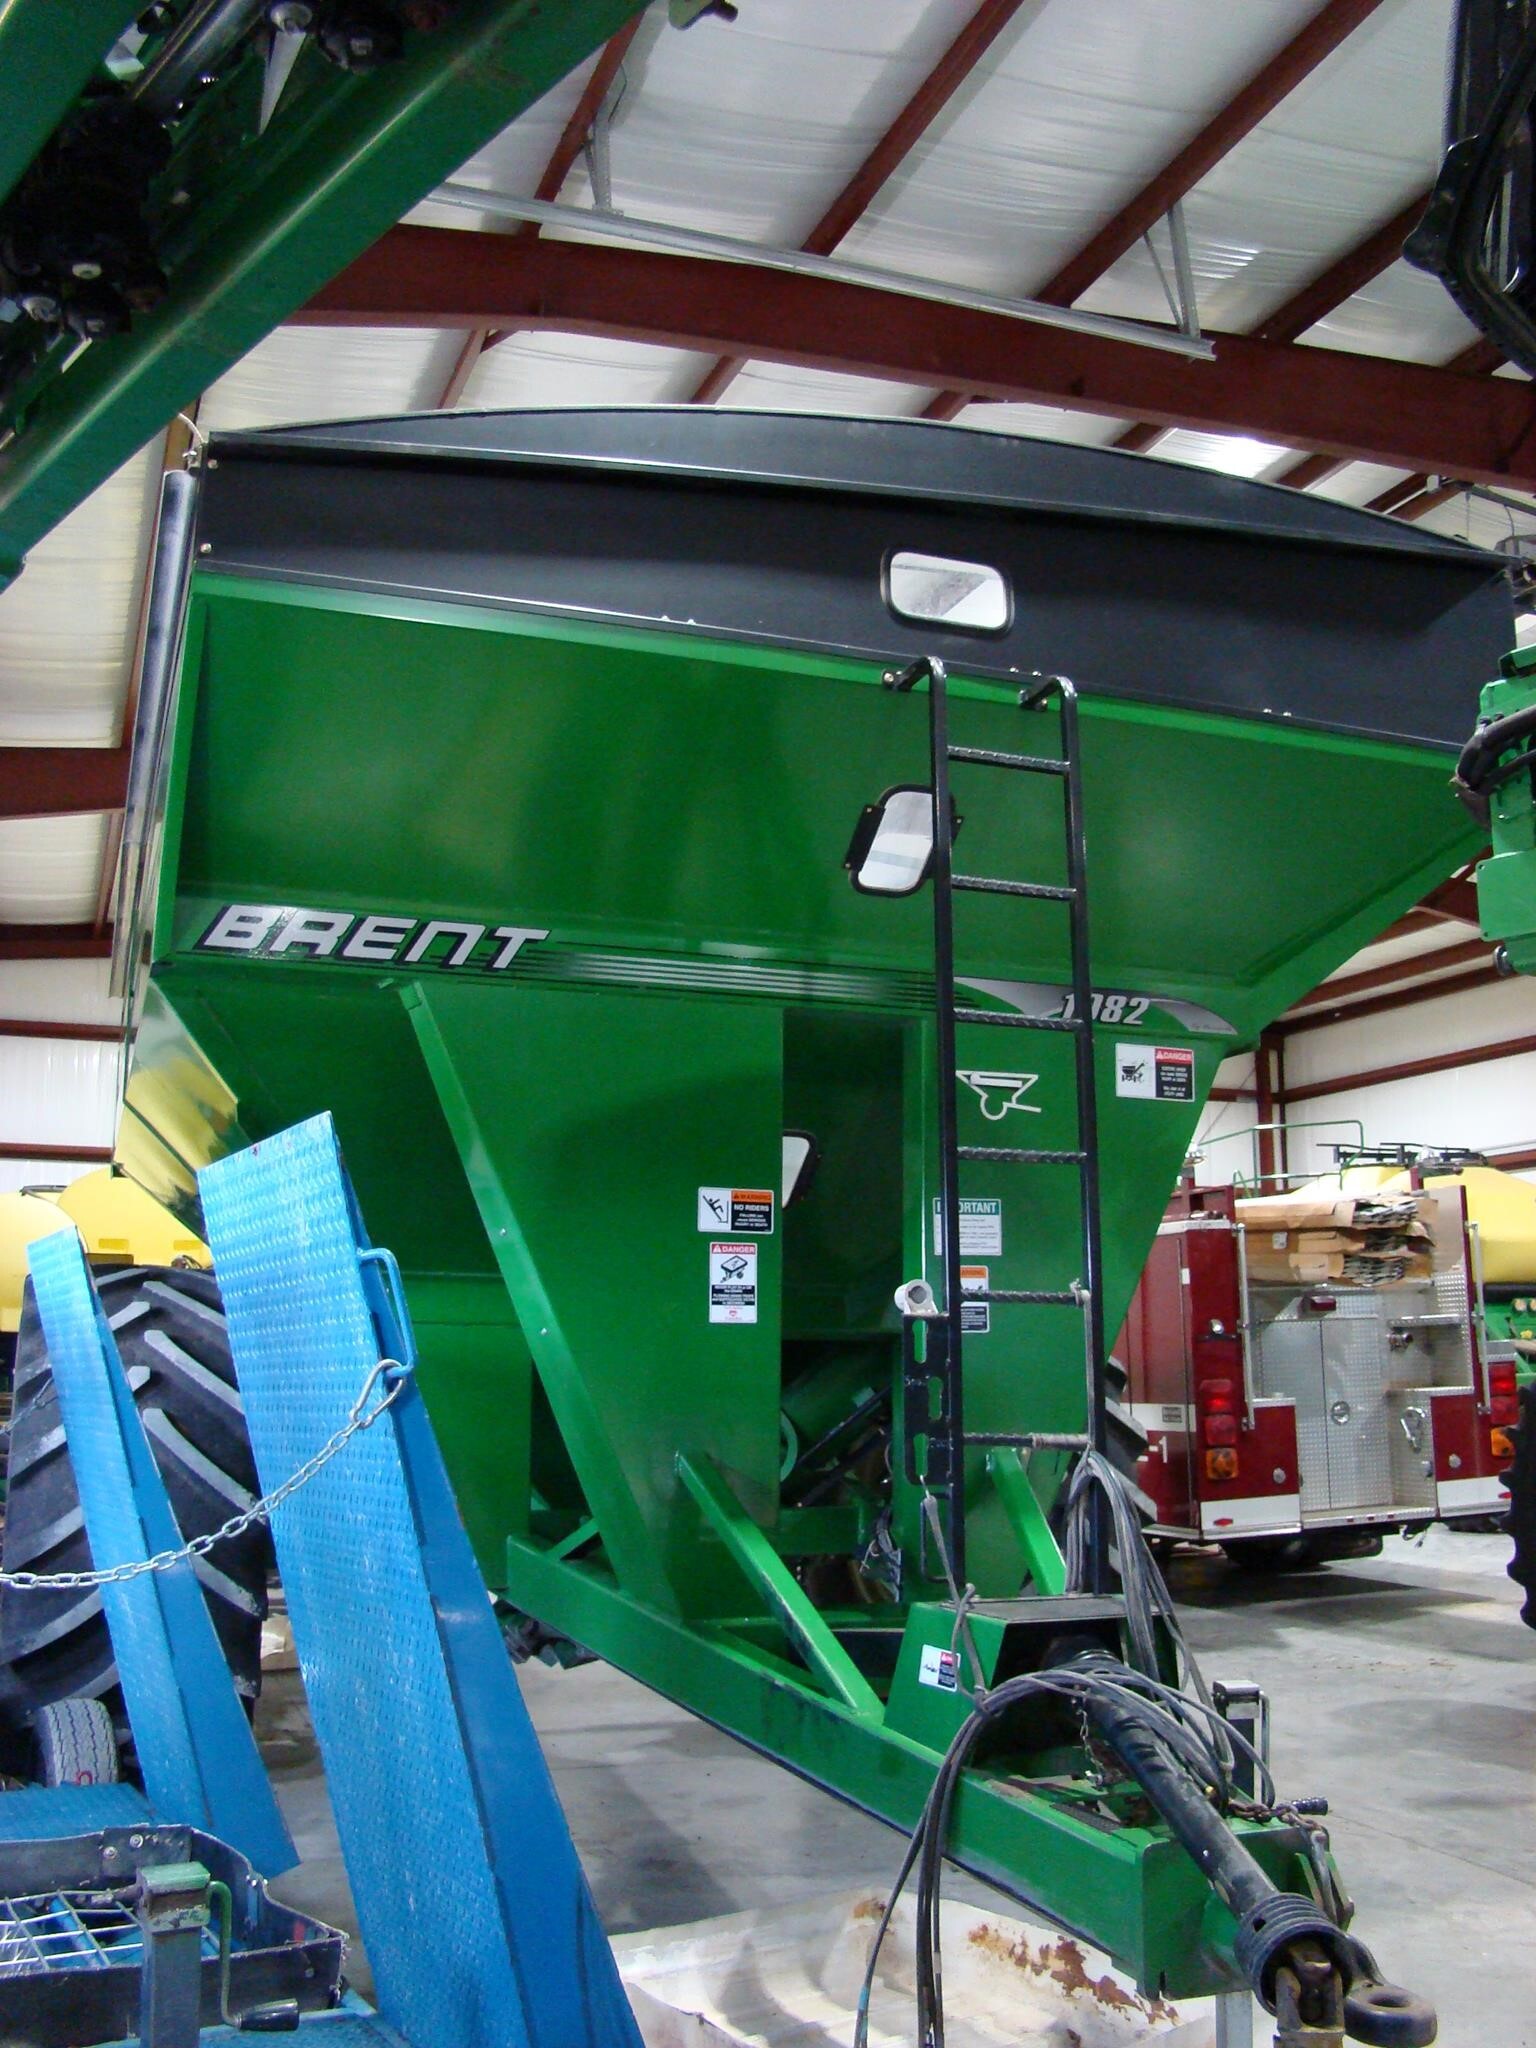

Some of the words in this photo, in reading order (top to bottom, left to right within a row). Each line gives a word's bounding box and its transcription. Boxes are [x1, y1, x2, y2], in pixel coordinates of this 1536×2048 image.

[200, 904, 550, 969] BRENT
[733, 1203, 744, 1211] NO
[937, 1201, 997, 1213] IORTANT
[722, 1245, 755, 1253] DANGER
